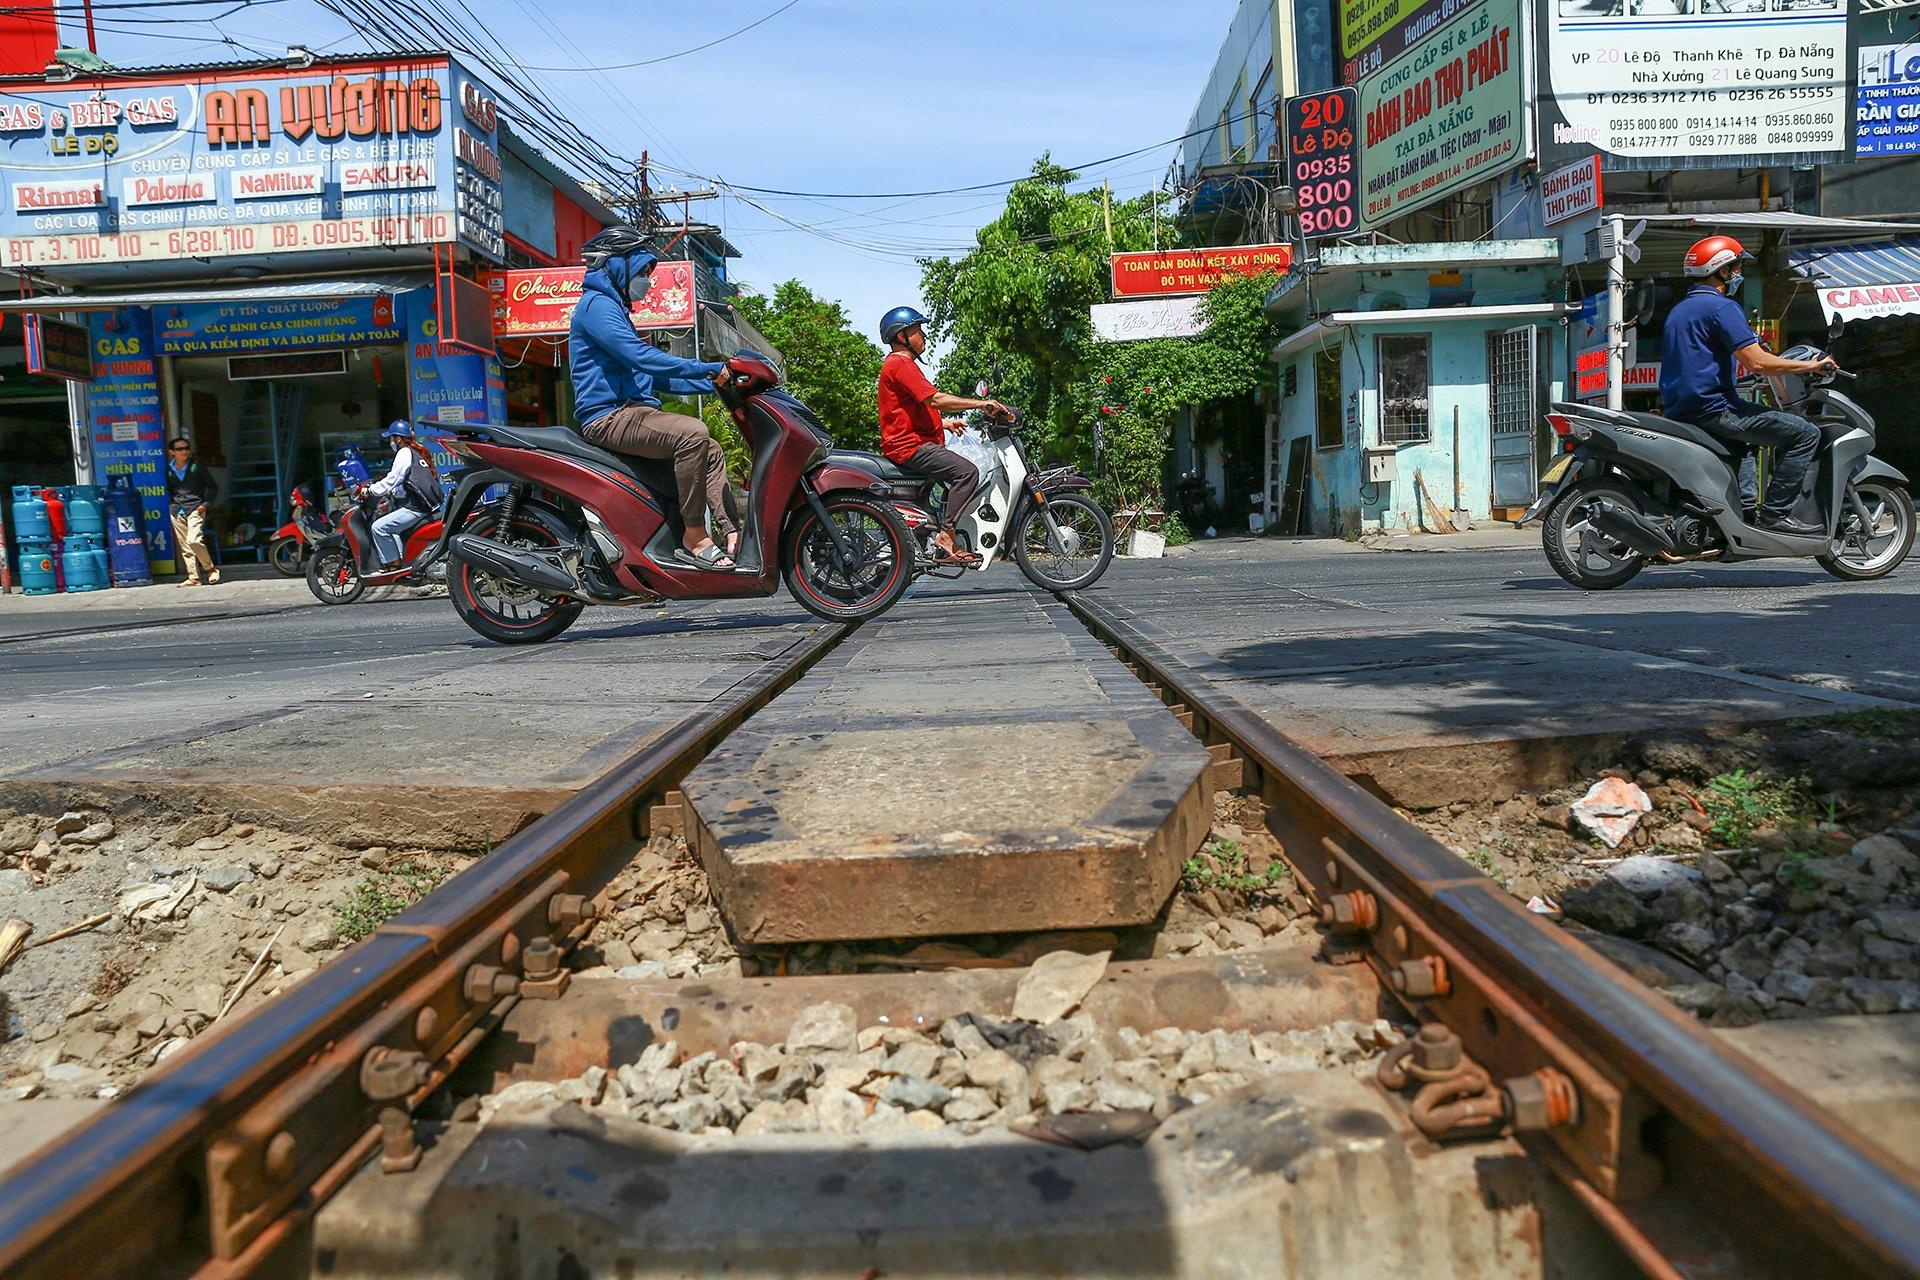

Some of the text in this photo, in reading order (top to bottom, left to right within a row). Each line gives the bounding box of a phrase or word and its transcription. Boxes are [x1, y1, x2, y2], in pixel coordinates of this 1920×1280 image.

[1347, 0, 1399, 50] 0935.898.800
[1404, 8, 1441, 47] Hotline:
[1380, 64, 1411, 94] CUNG
[1413, 45, 1438, 74] CẤP
[1457, 29, 1468, 46] &
[1471, 9, 1490, 37] LẺ
[1596, 48, 1620, 63] 20
[1624, 51, 1640, 63] Lê
[1643, 50, 1662, 66] Độ
[1672, 50, 1714, 62] Thanh
[1717, 48, 1743, 61] Khê
[1778, 46, 1796, 59] Đà
[1799, 42, 1834, 60] Nẵng
[1366, 24, 1511, 150] BÁNH BAO THỌ PHÁT
[1631, 71, 1659, 83] Nhà
[1711, 68, 1730, 81] 21
[1736, 67, 1751, 80] Lê
[1755, 68, 1797, 81] Quang
[1801, 66, 1834, 80] Sung
[1865, 89, 1889, 98] TNHH
[0, 90, 178, 130] GAS & BẾP GAS
[460, 81, 497, 135] GAS
[1301, 94, 1345, 129] 20
[1765, 112, 1834, 127] 0935.860.860
[1292, 128, 1353, 155] Lê Độ
[1395, 105, 1474, 159] TẠI ĐÀ NẴNG
[1873, 122, 1919, 135] GIẢI PHÁP
[52, 131, 119, 155] LÊ ĐỘ
[132, 154, 191, 174] CHUYÊN
[195, 153, 236, 170] CUNG
[241, 147, 270, 168] CẤP
[297, 144, 316, 164] LẺ
[320, 147, 350, 162] GAS
[355, 146, 366, 159] &
[371, 138, 400, 159] BẾP
[404, 141, 436, 157] GAS
[1885, 141, 1917, 151] 18 Lê Độ
[344, 164, 430, 186] SAKURA
[1296, 153, 1352, 181] 0935
[1368, 174, 1386, 196] NHẬN
[1386, 166, 1399, 187] ĐẶT
[1400, 158, 1420, 180] BÁNH
[1440, 138, 1457, 161] TIỆC
[134, 177, 204, 202] Paloma
[239, 173, 316, 194] NaMilux
[1298, 178, 1352, 208] 800
[1397, 182, 1421, 202] HOTLINE:
[1543, 163, 1593, 199] BÁNH BAO
[16, 183, 101, 209] Rinnai
[1546, 184, 1593, 219] THỌ PHÁT
[34, 213, 64, 231] CÁC
[107, 211, 137, 227] GAS
[141, 206, 184, 225] CHÍNH
[235, 201, 256, 219] ĐÃ
[260, 202, 290, 218] QUA
[295, 197, 328, 216] KIỂM
[336, 197, 368, 213] ĐỊNH
[374, 194, 393, 210] AN
[398, 191, 438, 209] TOÀN
[1299, 205, 1352, 234] 800
[1123, 258, 1150, 272] TOÀN
[1177, 255, 1204, 269] ĐOÀN
[1230, 253, 1250, 266] XÂY
[513, 275, 564, 302] Chúc
[1161, 272, 1175, 287] ĐÔ
[1178, 273, 1195, 288] THỊ
[220, 308, 237, 317] UY
[240, 304, 258, 316] TÍN
[266, 300, 298, 315] CHẤT
[166, 319, 189, 329] GAS
[230, 321, 257, 333] BÌNH
[260, 320, 283, 331] GAS
[285, 317, 321, 329] CHÍNH
[97, 337, 140, 356] GAS
[183, 341, 208, 353] QUA
[210, 335, 238, 350] KIỂM
[241, 337, 270, 350] ĐỊNH
[272, 334, 288, 346] VÀ
[317, 327, 346, 343] HIỂM
[348, 331, 365, 341] AN
[367, 328, 400, 340] TOÀN
[415, 343, 432, 358] AN
[147, 448, 164, 456] GAS
